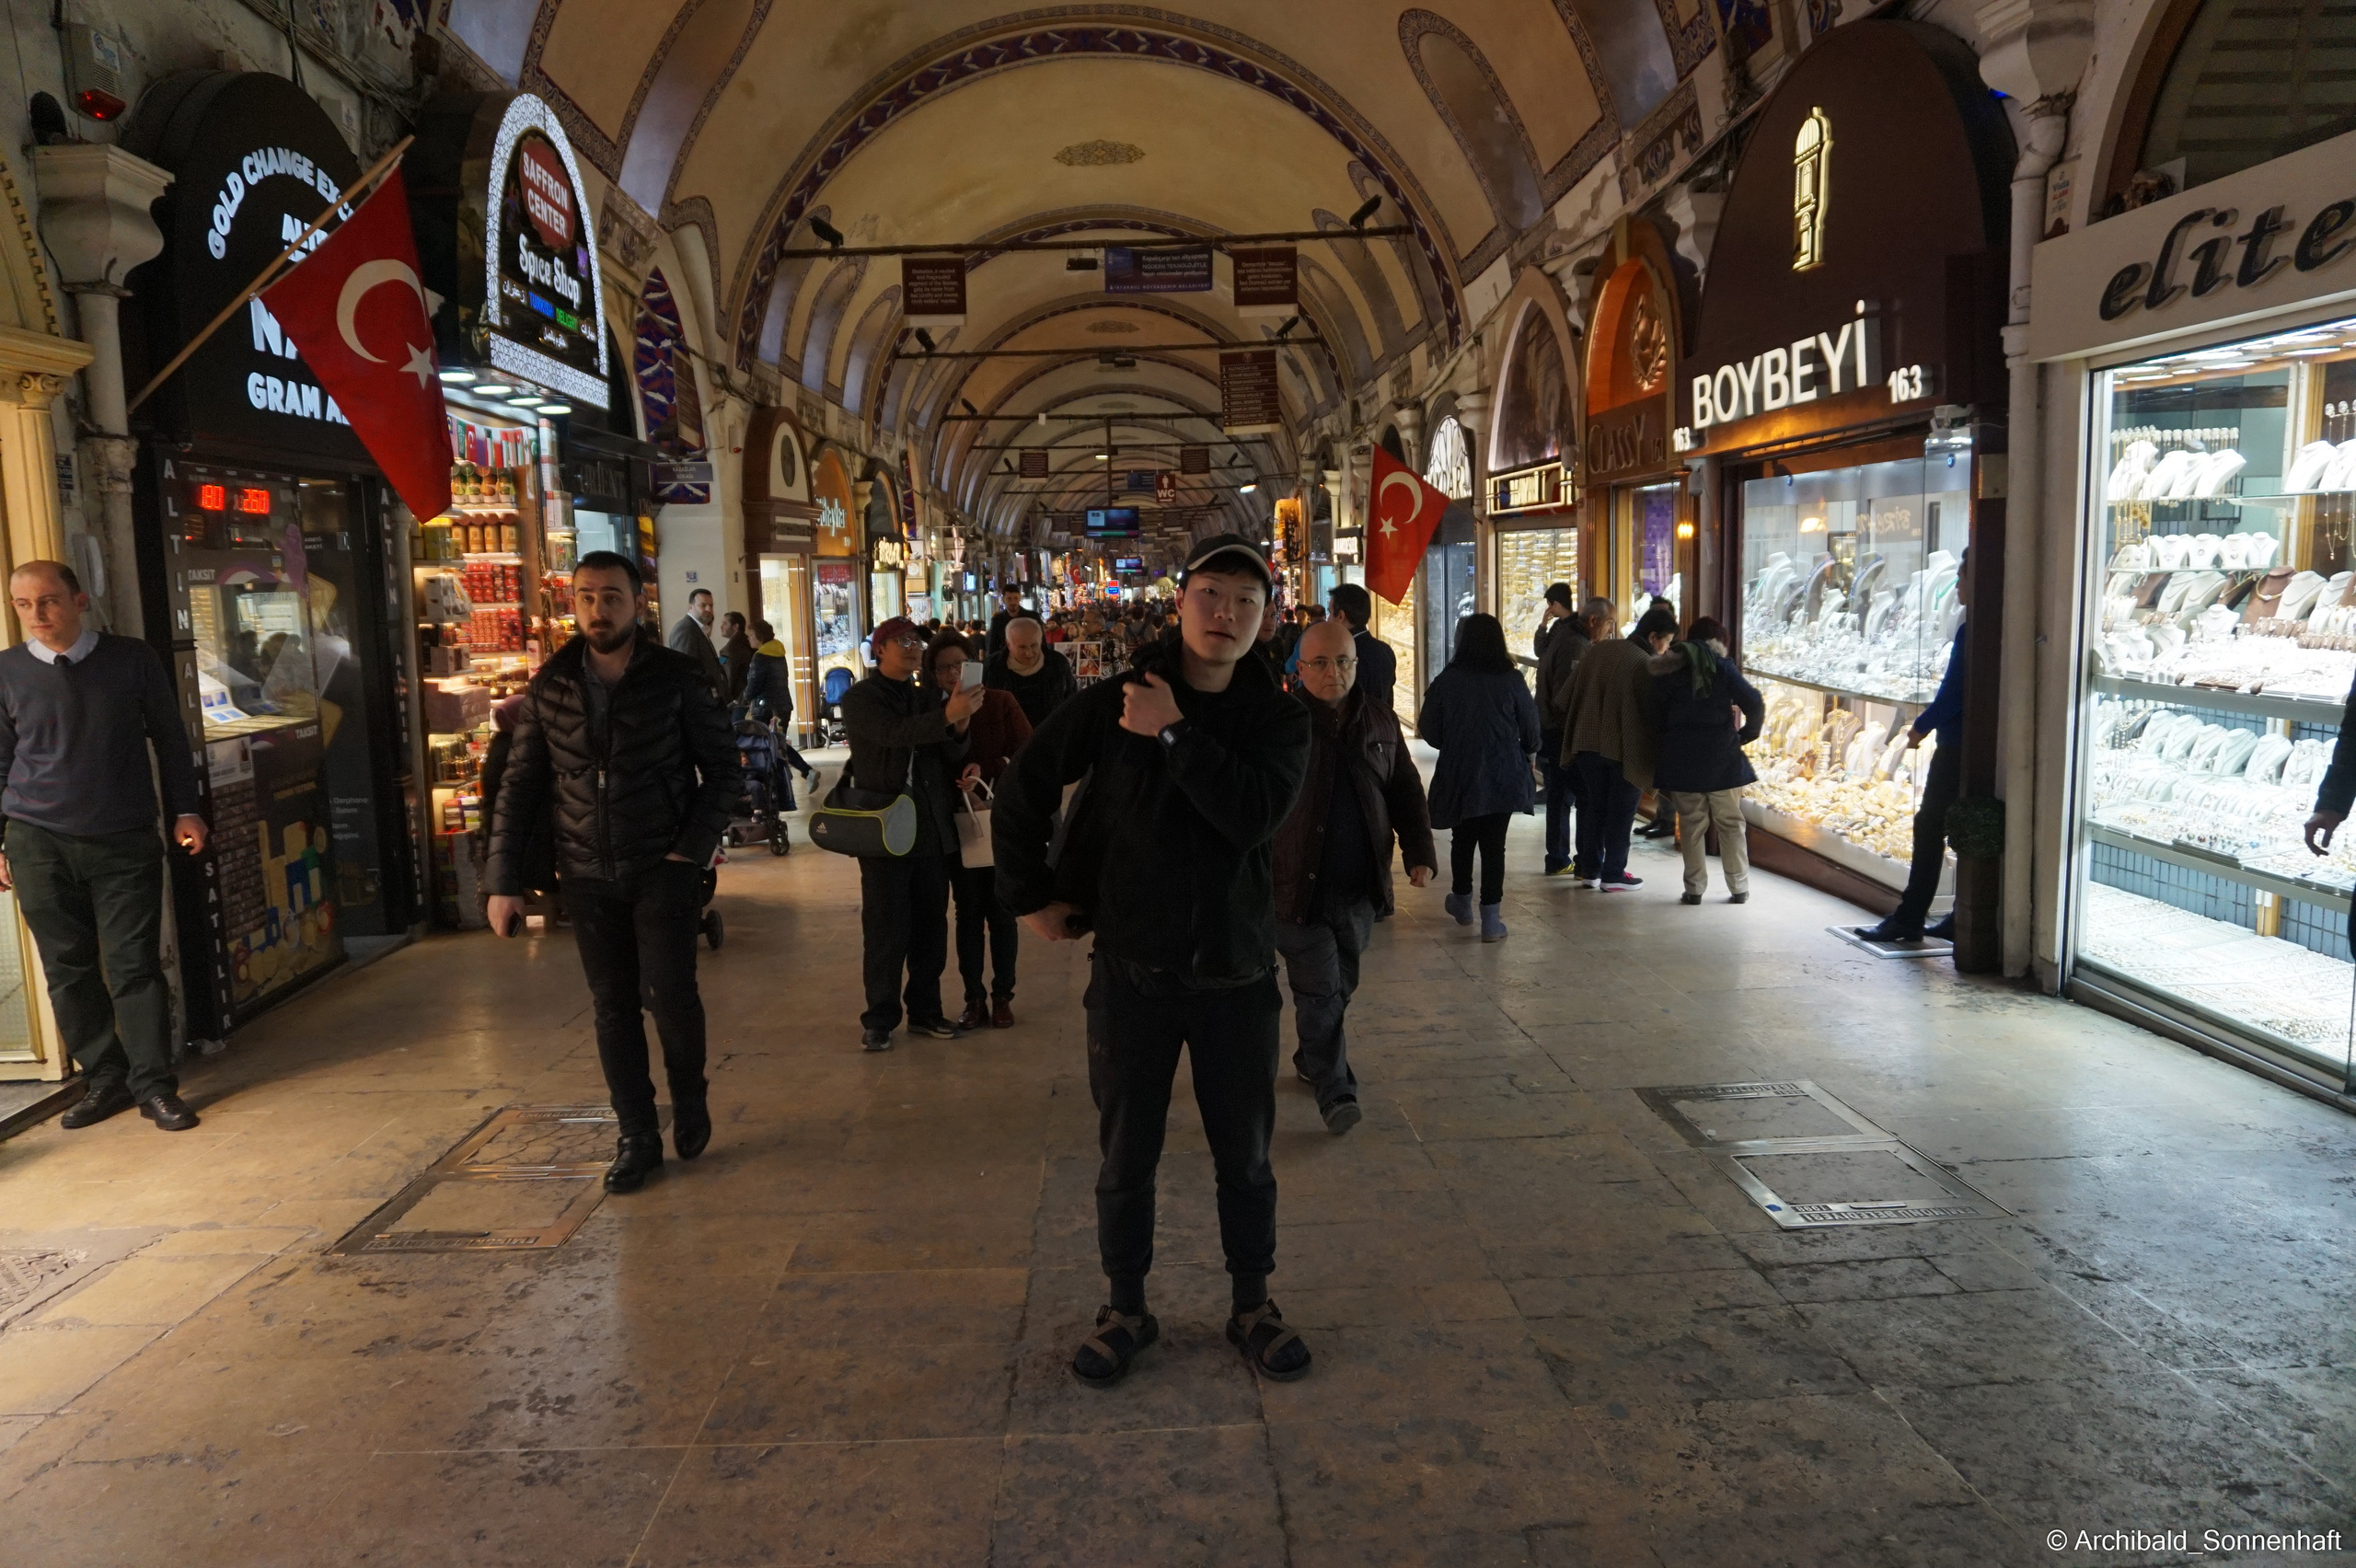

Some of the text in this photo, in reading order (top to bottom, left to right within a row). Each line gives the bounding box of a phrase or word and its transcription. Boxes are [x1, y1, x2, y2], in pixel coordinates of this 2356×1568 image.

[208, 172, 245, 259] GOLD
[243, 146, 315, 186] CHANGE
[523, 152, 568, 211] SAFFRON
[527, 189, 567, 238] CENTER
[519, 234, 582, 310] Spice Shop
[2099, 200, 2356, 320] elite
[250, 296, 298, 360] N
[529, 291, 578, 332] TURKISH DELIGHT
[1692, 300, 1923, 429] BOYBEYİ 163
[248, 372, 351, 426] GRAM A
[1651, 438, 1663, 463] 161
[1673, 427, 1691, 452] 163
[1157, 489, 1174, 498] WC
[1803, 1208, 1899, 1222] BELEDİYESİ
